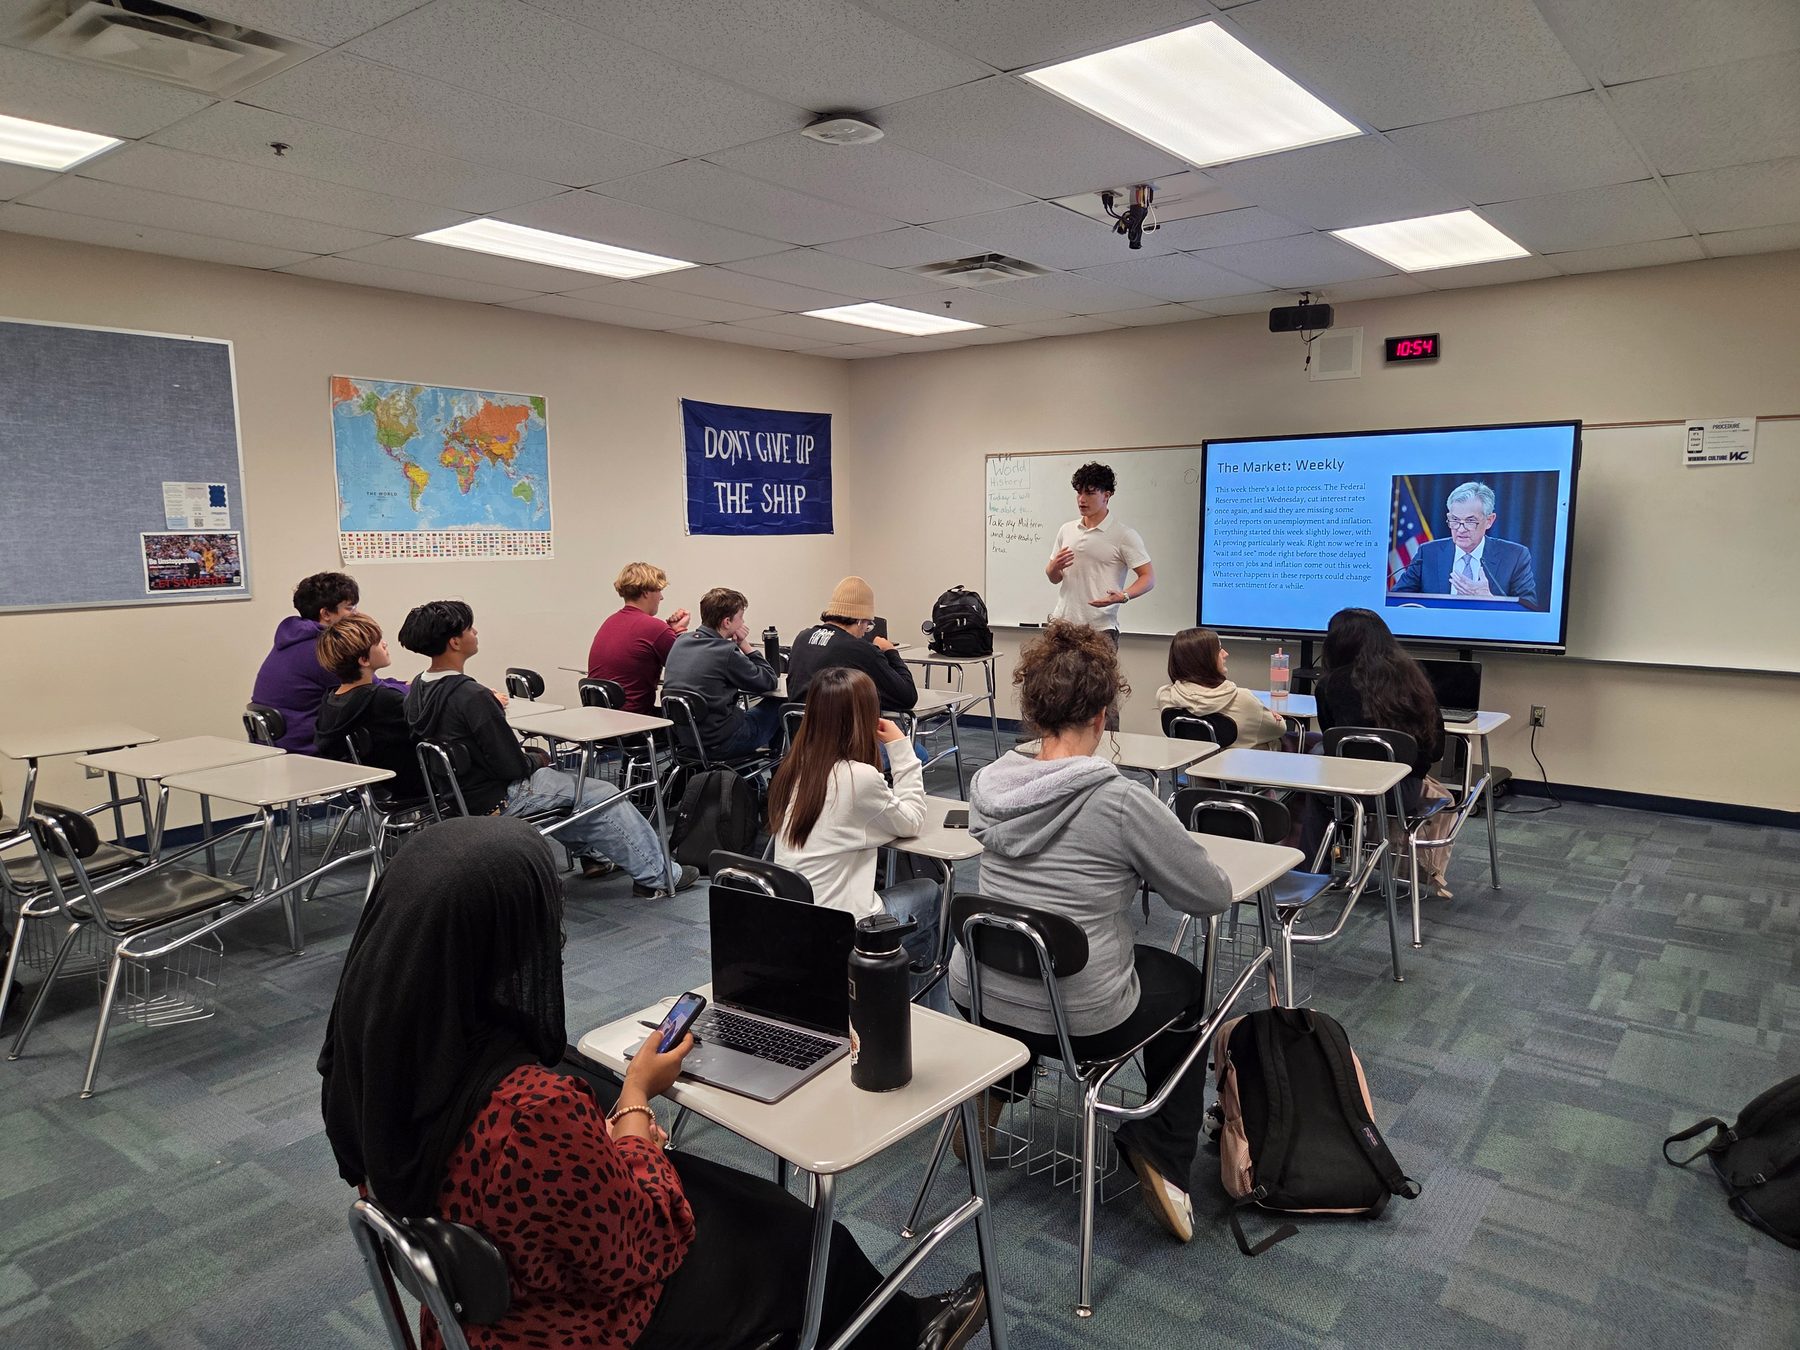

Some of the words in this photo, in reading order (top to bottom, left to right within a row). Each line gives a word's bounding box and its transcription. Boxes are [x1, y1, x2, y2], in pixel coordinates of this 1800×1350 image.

[1396, 340, 1432, 356] 10:54
[756, 432, 791, 464] GIVE
[796, 434, 814, 464] UP
[1730, 451, 1749, 460] WC
[1218, 462, 1239, 473] The
[1243, 460, 1291, 473] Market:
[1296, 458, 1345, 472] Weekly
[714, 482, 752, 514] THE
[761, 484, 806, 514] SHIP
[1267, 496, 1306, 504] Wednesday,
[1279, 507, 1293, 515] they
[1307, 507, 1334, 515] missing
[1274, 518, 1324, 526] unemployment
[1214, 529, 1248, 537] Everything
[1306, 528, 1330, 537] slightly
[1307, 540, 1326, 548] Right
[1278, 550, 1294, 559] right
[1339, 551, 1366, 559] delayed
[1244, 571, 1270, 579] happens
[1346, 573, 1371, 582] change
